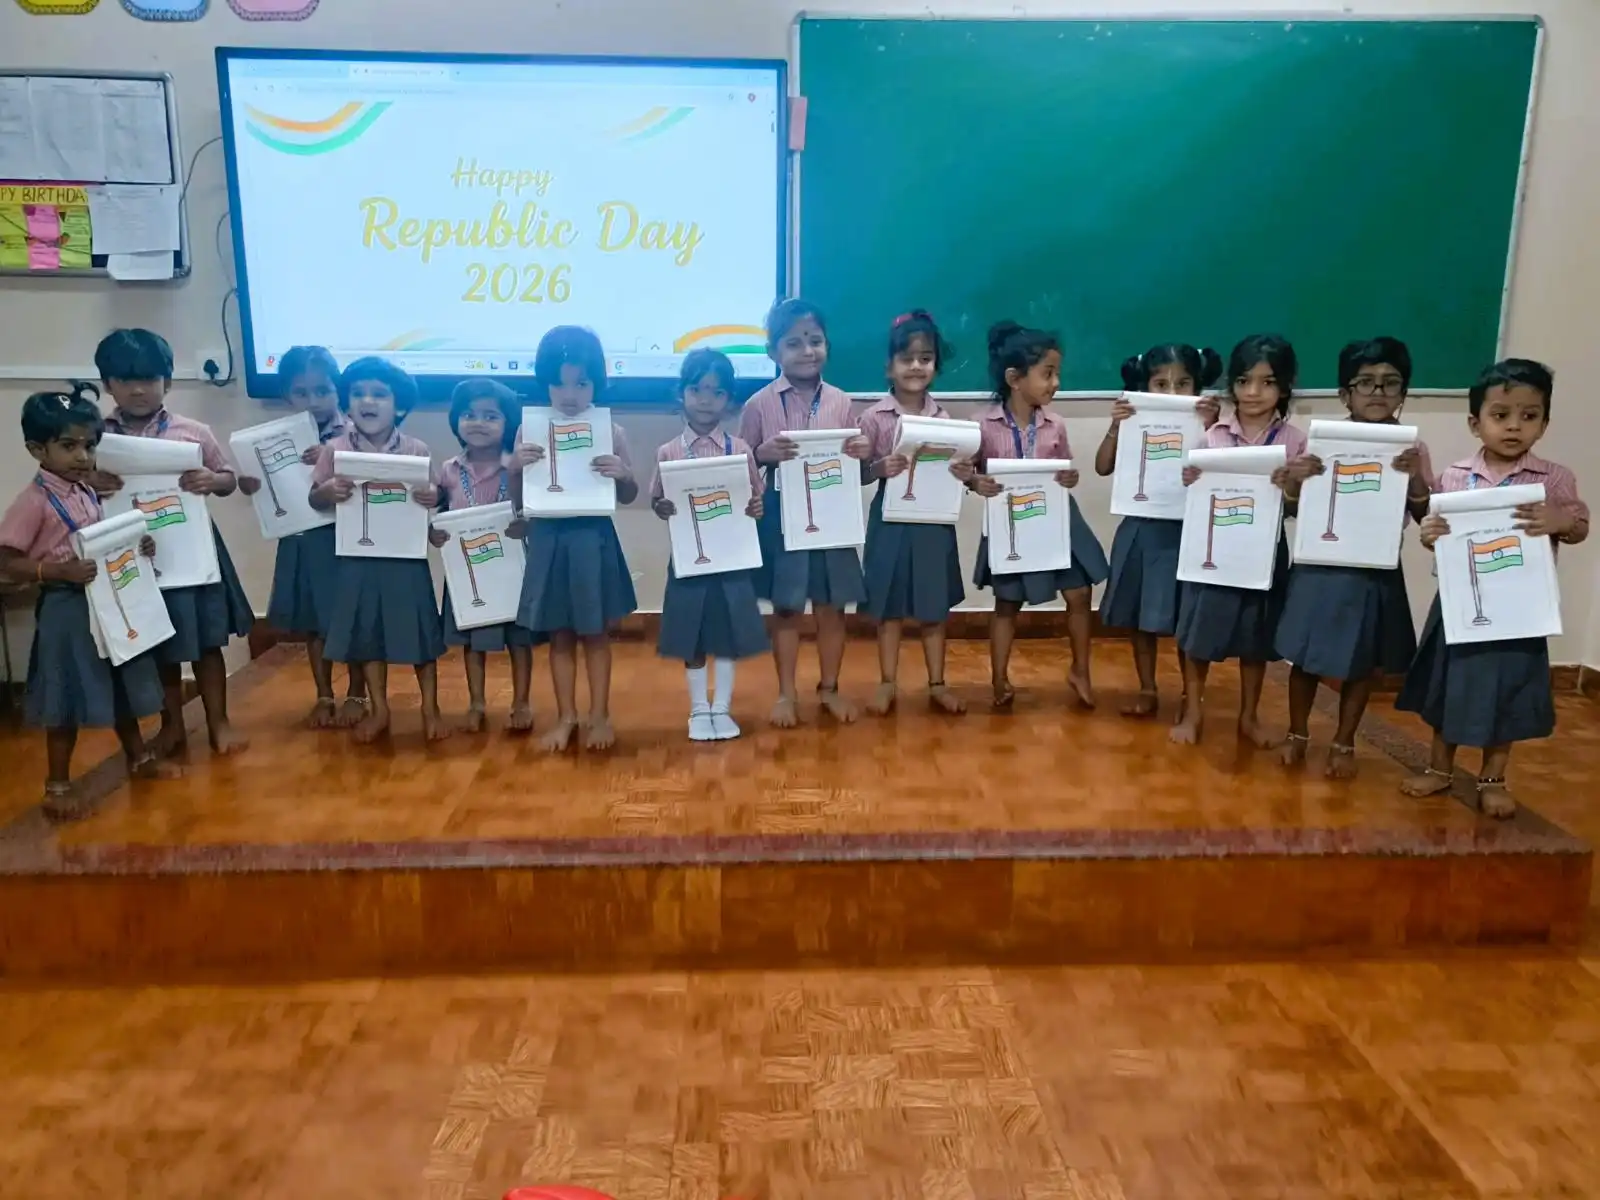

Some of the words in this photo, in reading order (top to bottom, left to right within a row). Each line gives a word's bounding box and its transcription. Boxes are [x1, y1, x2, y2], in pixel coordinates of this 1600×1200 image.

[451, 157, 553, 197] Happy
[359, 197, 578, 263] Republic
[597, 200, 704, 267] Day
[461, 262, 572, 303] 2026
